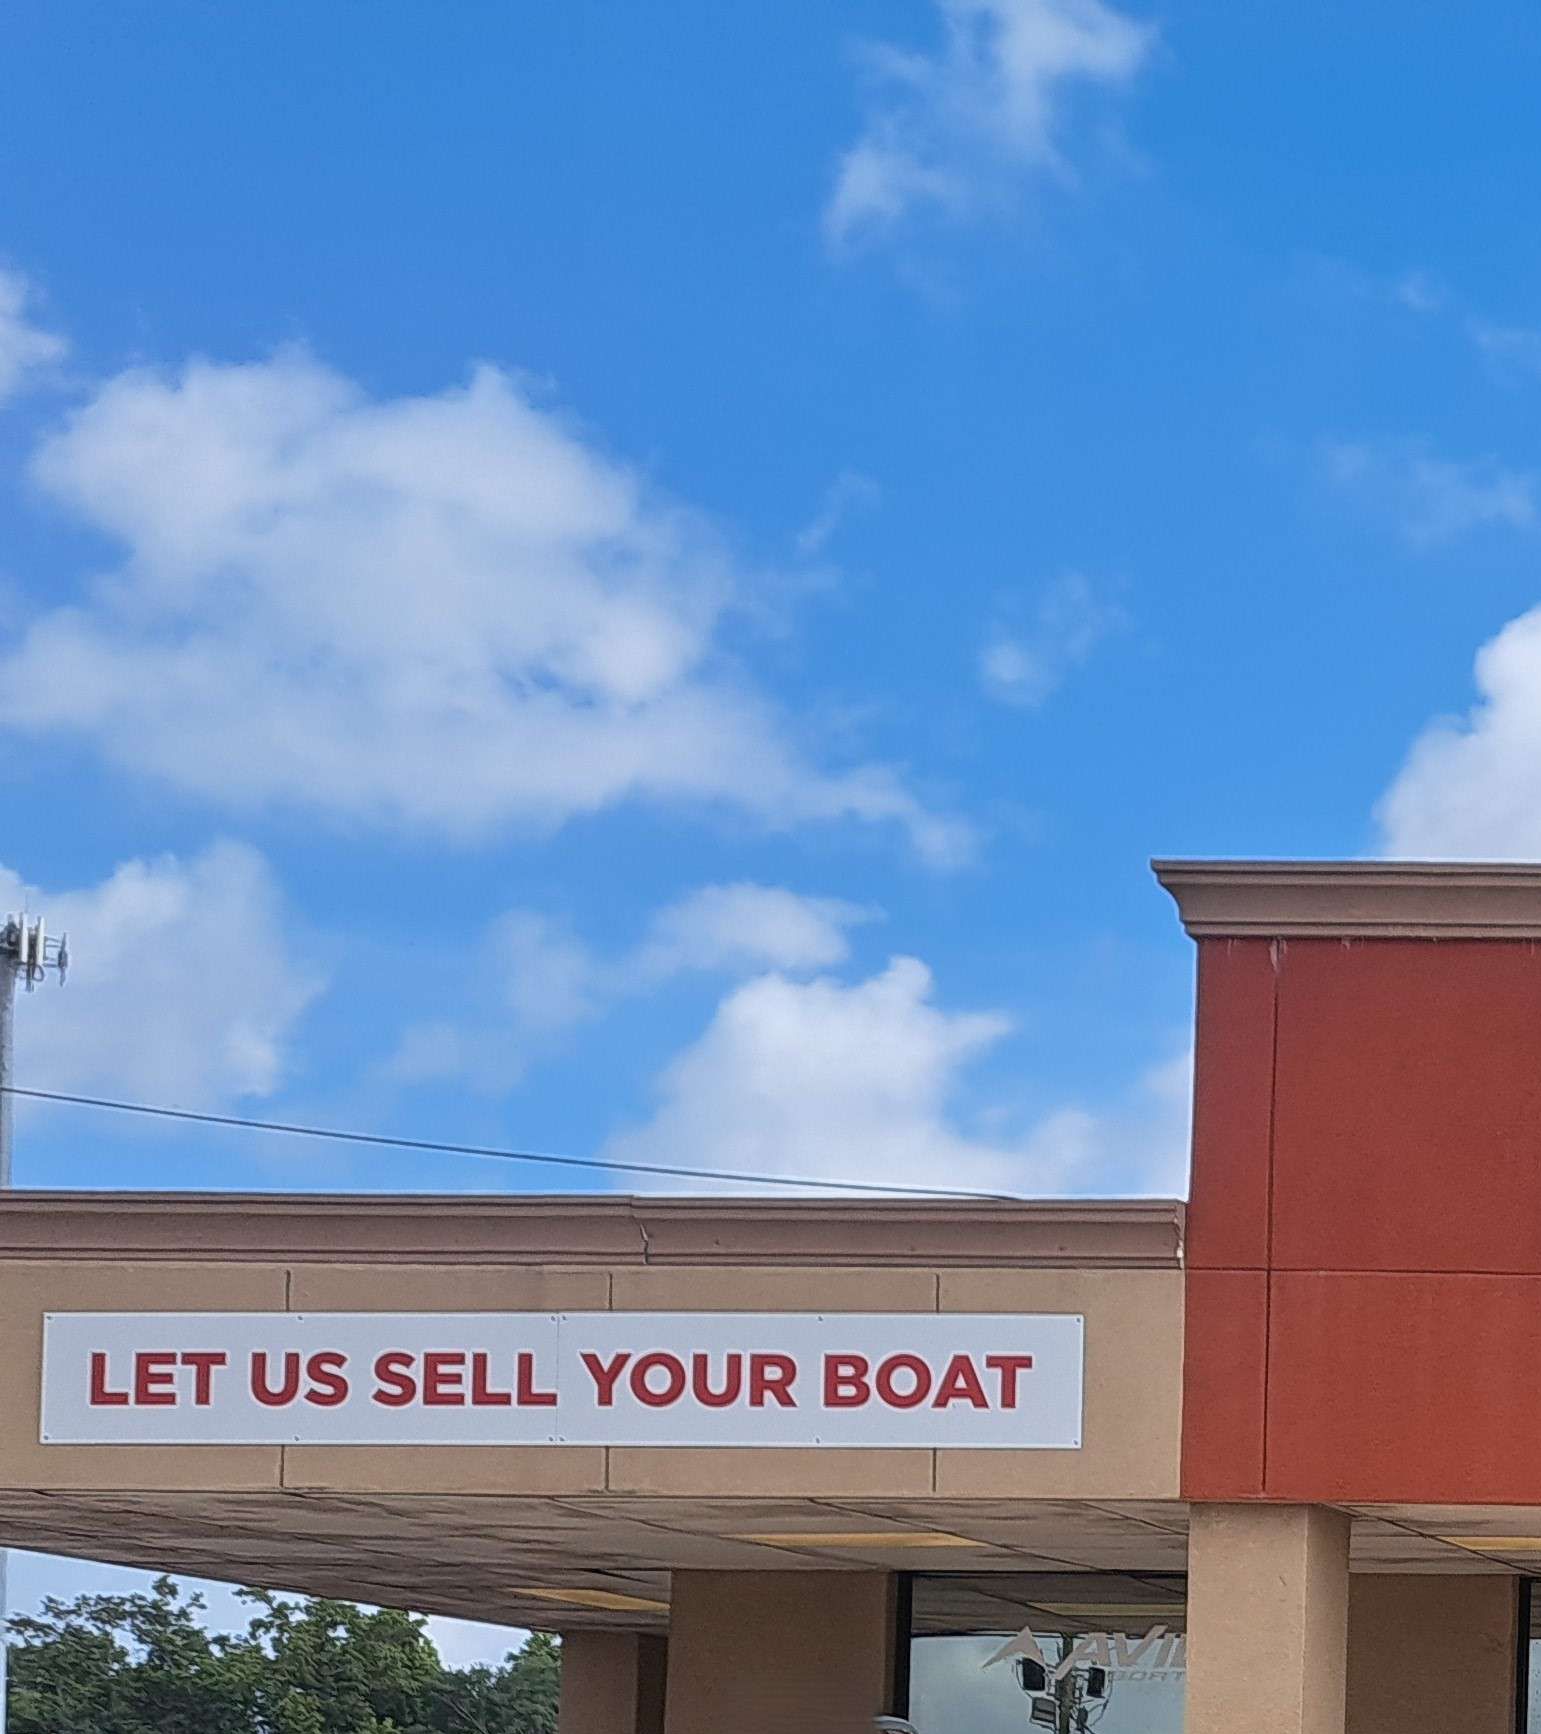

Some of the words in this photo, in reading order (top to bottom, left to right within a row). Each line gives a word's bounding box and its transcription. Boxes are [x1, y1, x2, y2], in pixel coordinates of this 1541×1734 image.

[90, 1351, 227, 1406] LET
[250, 1351, 350, 1406] US
[372, 1351, 558, 1407] SELL
[580, 1352, 798, 1408] YOUR
[822, 1353, 1034, 1409] BOAT
